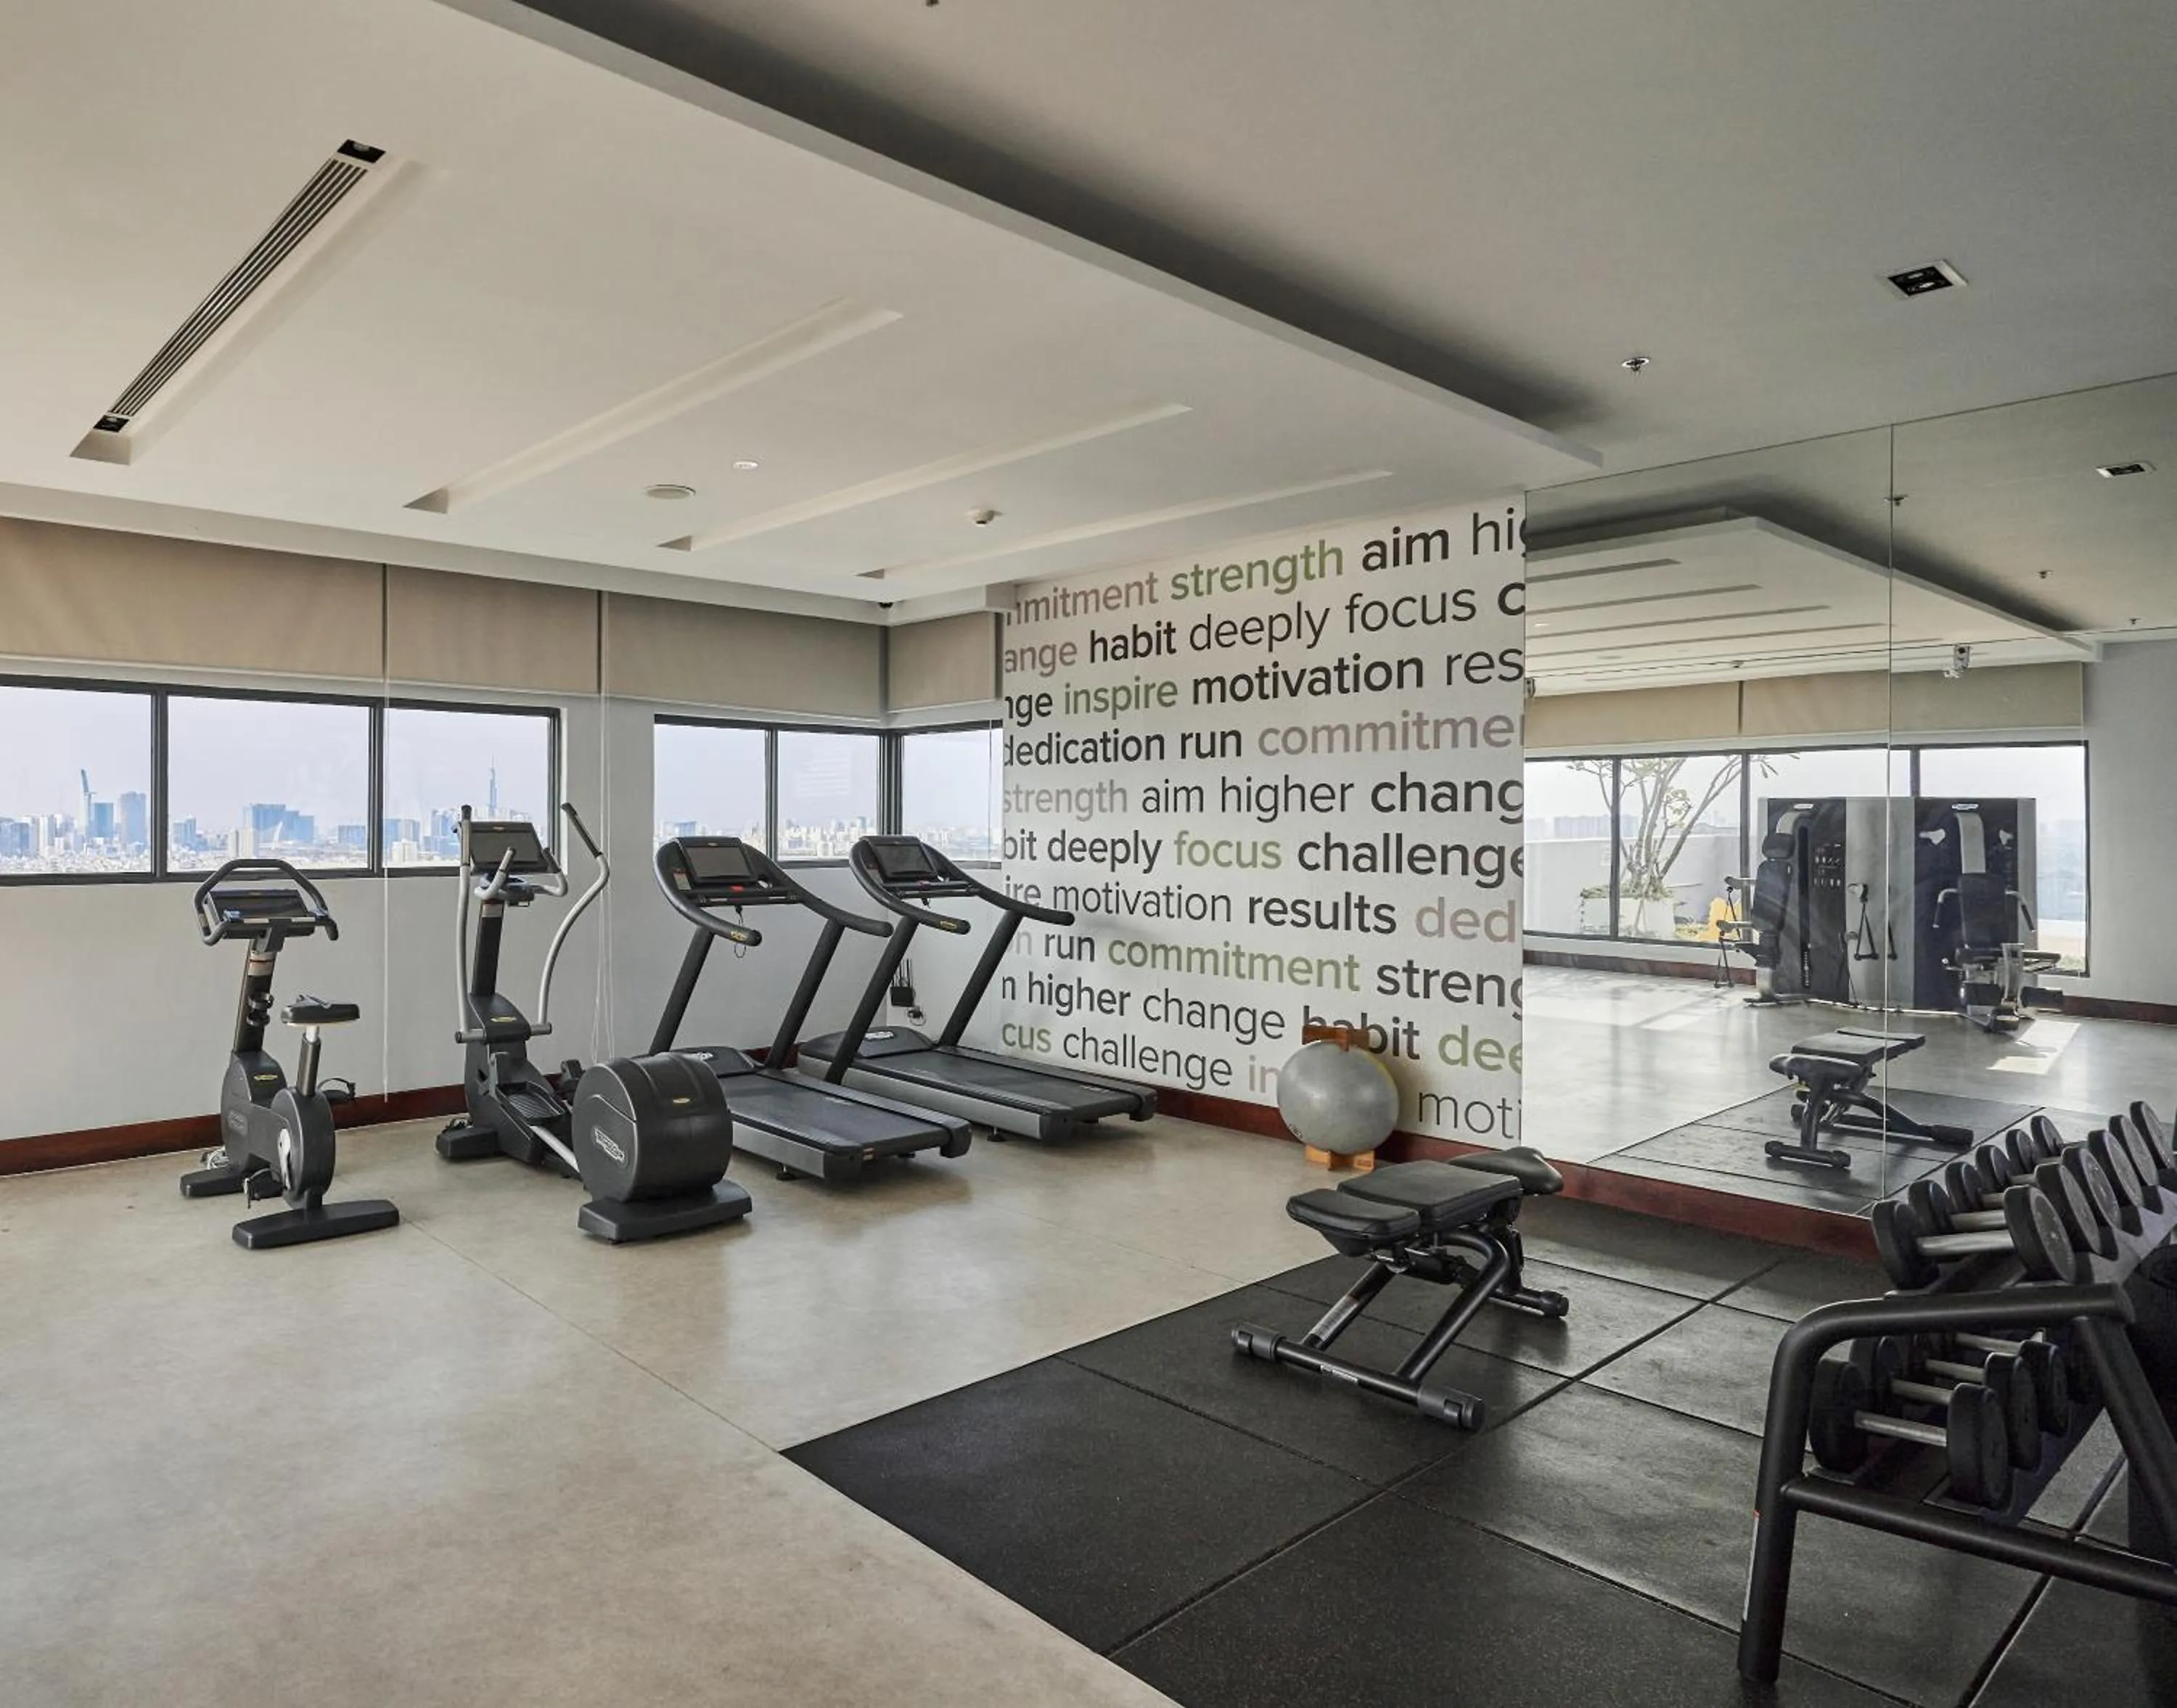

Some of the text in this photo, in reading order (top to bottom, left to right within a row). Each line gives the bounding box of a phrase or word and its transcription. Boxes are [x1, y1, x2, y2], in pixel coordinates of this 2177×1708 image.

[1171, 539, 1343, 600] strength
[1362, 526, 1449, 572] aim
[1472, 507, 1525, 557] hi
[1004, 582, 1525, 678] ange habit deeply focus c
[1065, 675, 1178, 720] inspire
[1193, 653, 1423, 705] motivation
[1446, 648, 1524, 686] res
[1181, 729, 1242, 760] run
[1003, 779, 1128, 821] strength
[1141, 778, 1204, 813] aim
[1221, 774, 1355, 824] higher
[1004, 828, 1037, 861] bit
[1047, 829, 1162, 874] deeply
[1173, 830, 1282, 869] focus
[1053, 882, 1231, 922] motivation
[1249, 892, 1397, 935] results
[1416, 896, 1516, 943] ded
[1044, 934, 1095, 962] run
[1107, 940, 1360, 993] commitment
[1028, 970, 1131, 1017] higher
[1143, 988, 1285, 1046] change
[1001, 1023, 1051, 1053] cus
[1063, 1027, 1232, 1090] challenge
